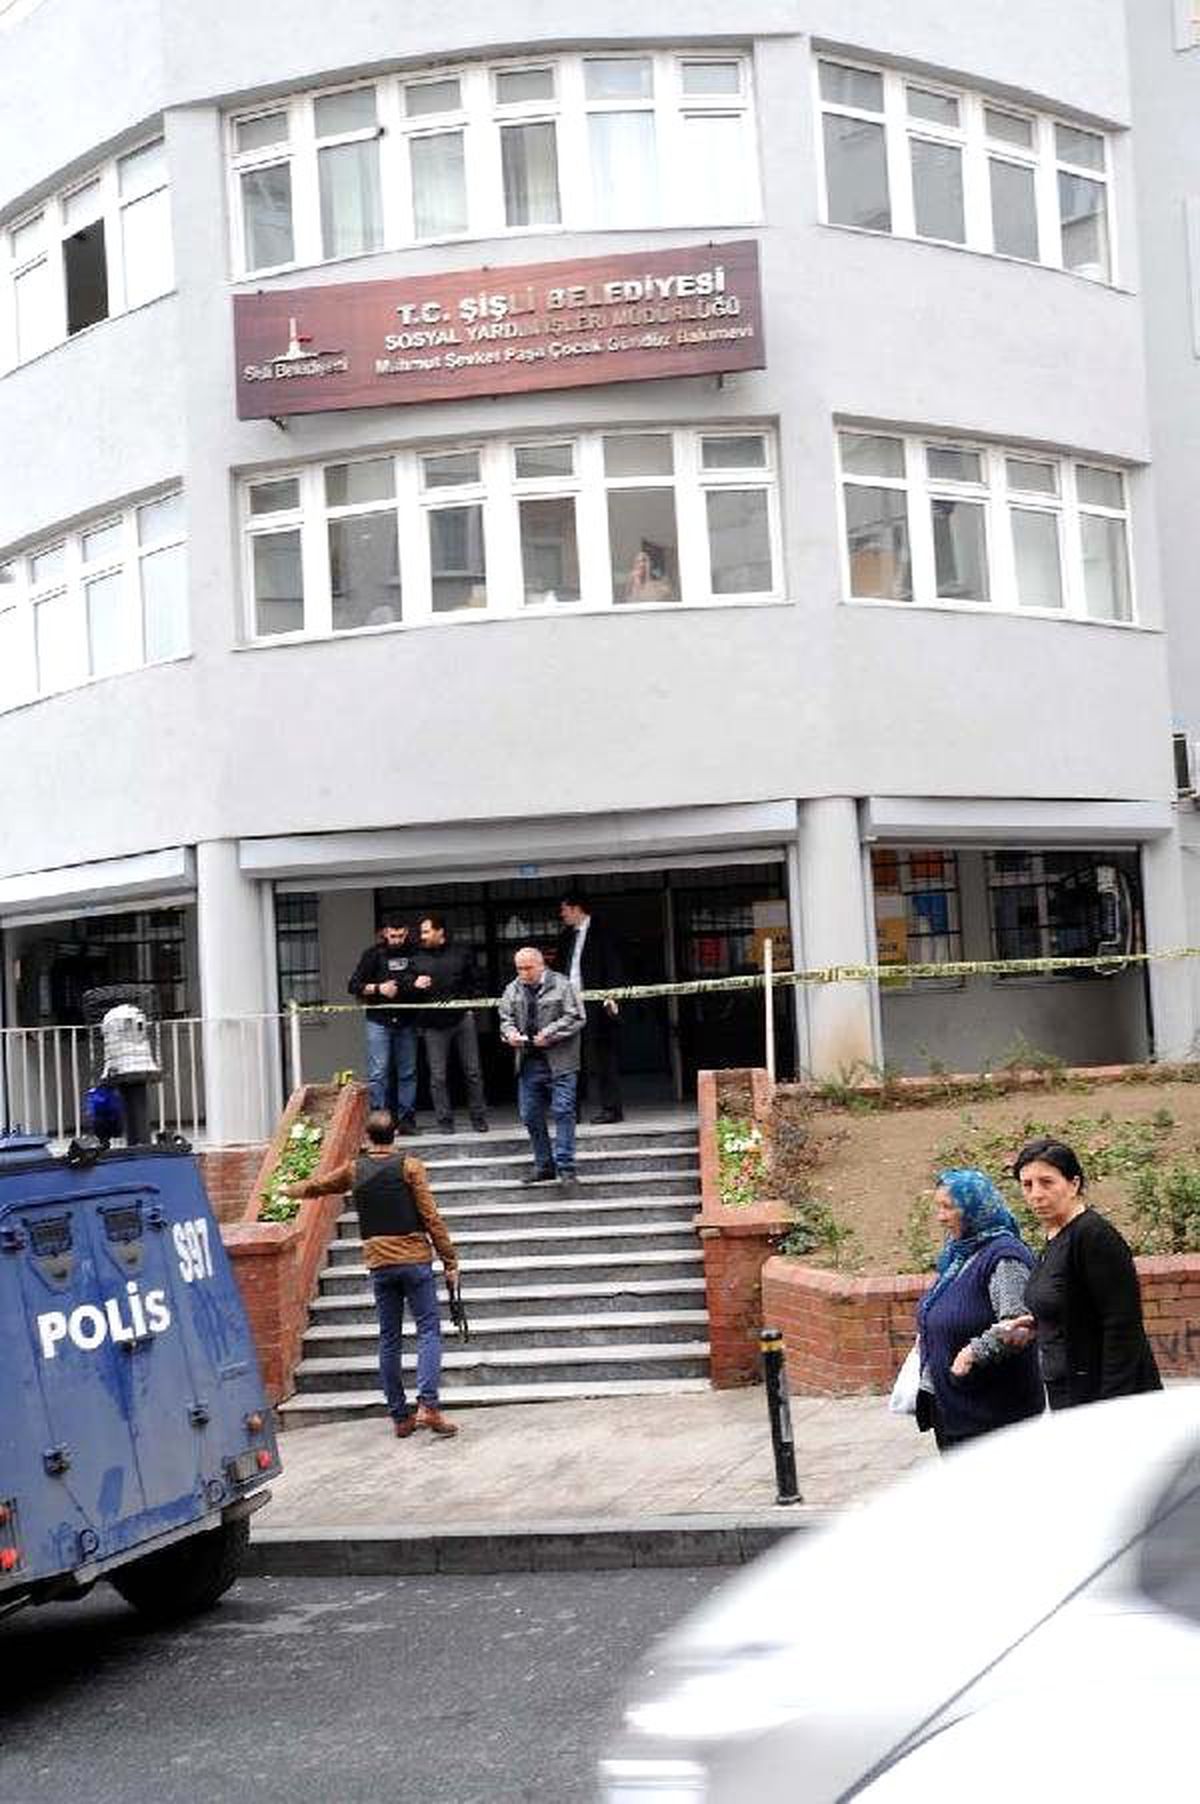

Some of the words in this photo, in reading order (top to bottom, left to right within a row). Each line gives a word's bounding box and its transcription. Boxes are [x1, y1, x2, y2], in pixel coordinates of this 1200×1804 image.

[384, 328, 461, 351] SOSYAL
[612, 296, 741, 327] MÜDÜRLÜĞÜ
[396, 302, 451, 326] T.C.
[458, 286, 535, 326] ŞİŞLİ
[548, 266, 725, 310] BELEDİYESİ
[37, 1281, 171, 1359] POLİS
